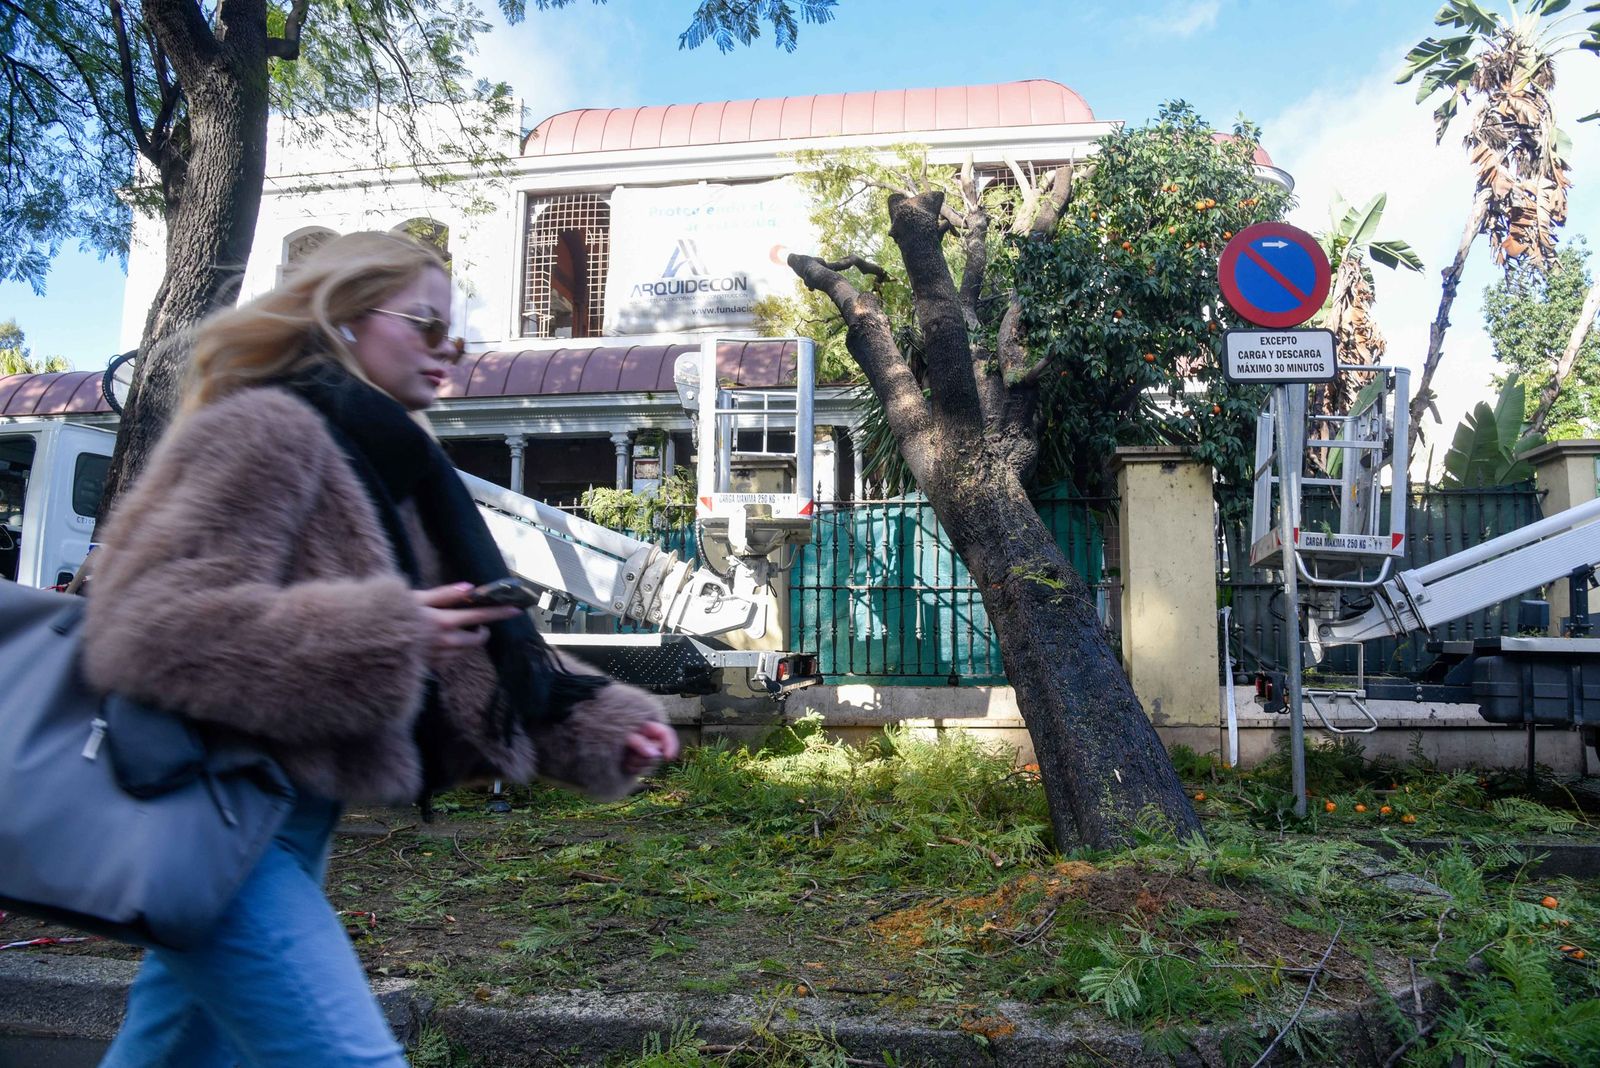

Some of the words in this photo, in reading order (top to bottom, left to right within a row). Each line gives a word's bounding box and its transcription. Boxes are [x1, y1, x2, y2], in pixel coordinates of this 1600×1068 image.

[630, 277, 747, 298] ARQUIDECON
[1260, 336, 1297, 345] EXCEPTO
[1238, 350, 1267, 360] CARGA
[1268, 350, 1274, 359] Y
[1276, 349, 1322, 359] DESCARGA
[1237, 362, 1272, 373] MÁXIMO
[1274, 364, 1285, 373] 30
[1287, 363, 1325, 372] MINUTOS
[757, 494, 768, 503] 250
[769, 494, 776, 503] KG
[1305, 536, 1322, 547] CARGA
[1347, 538, 1358, 548] 250
[1359, 539, 1367, 549] KG
